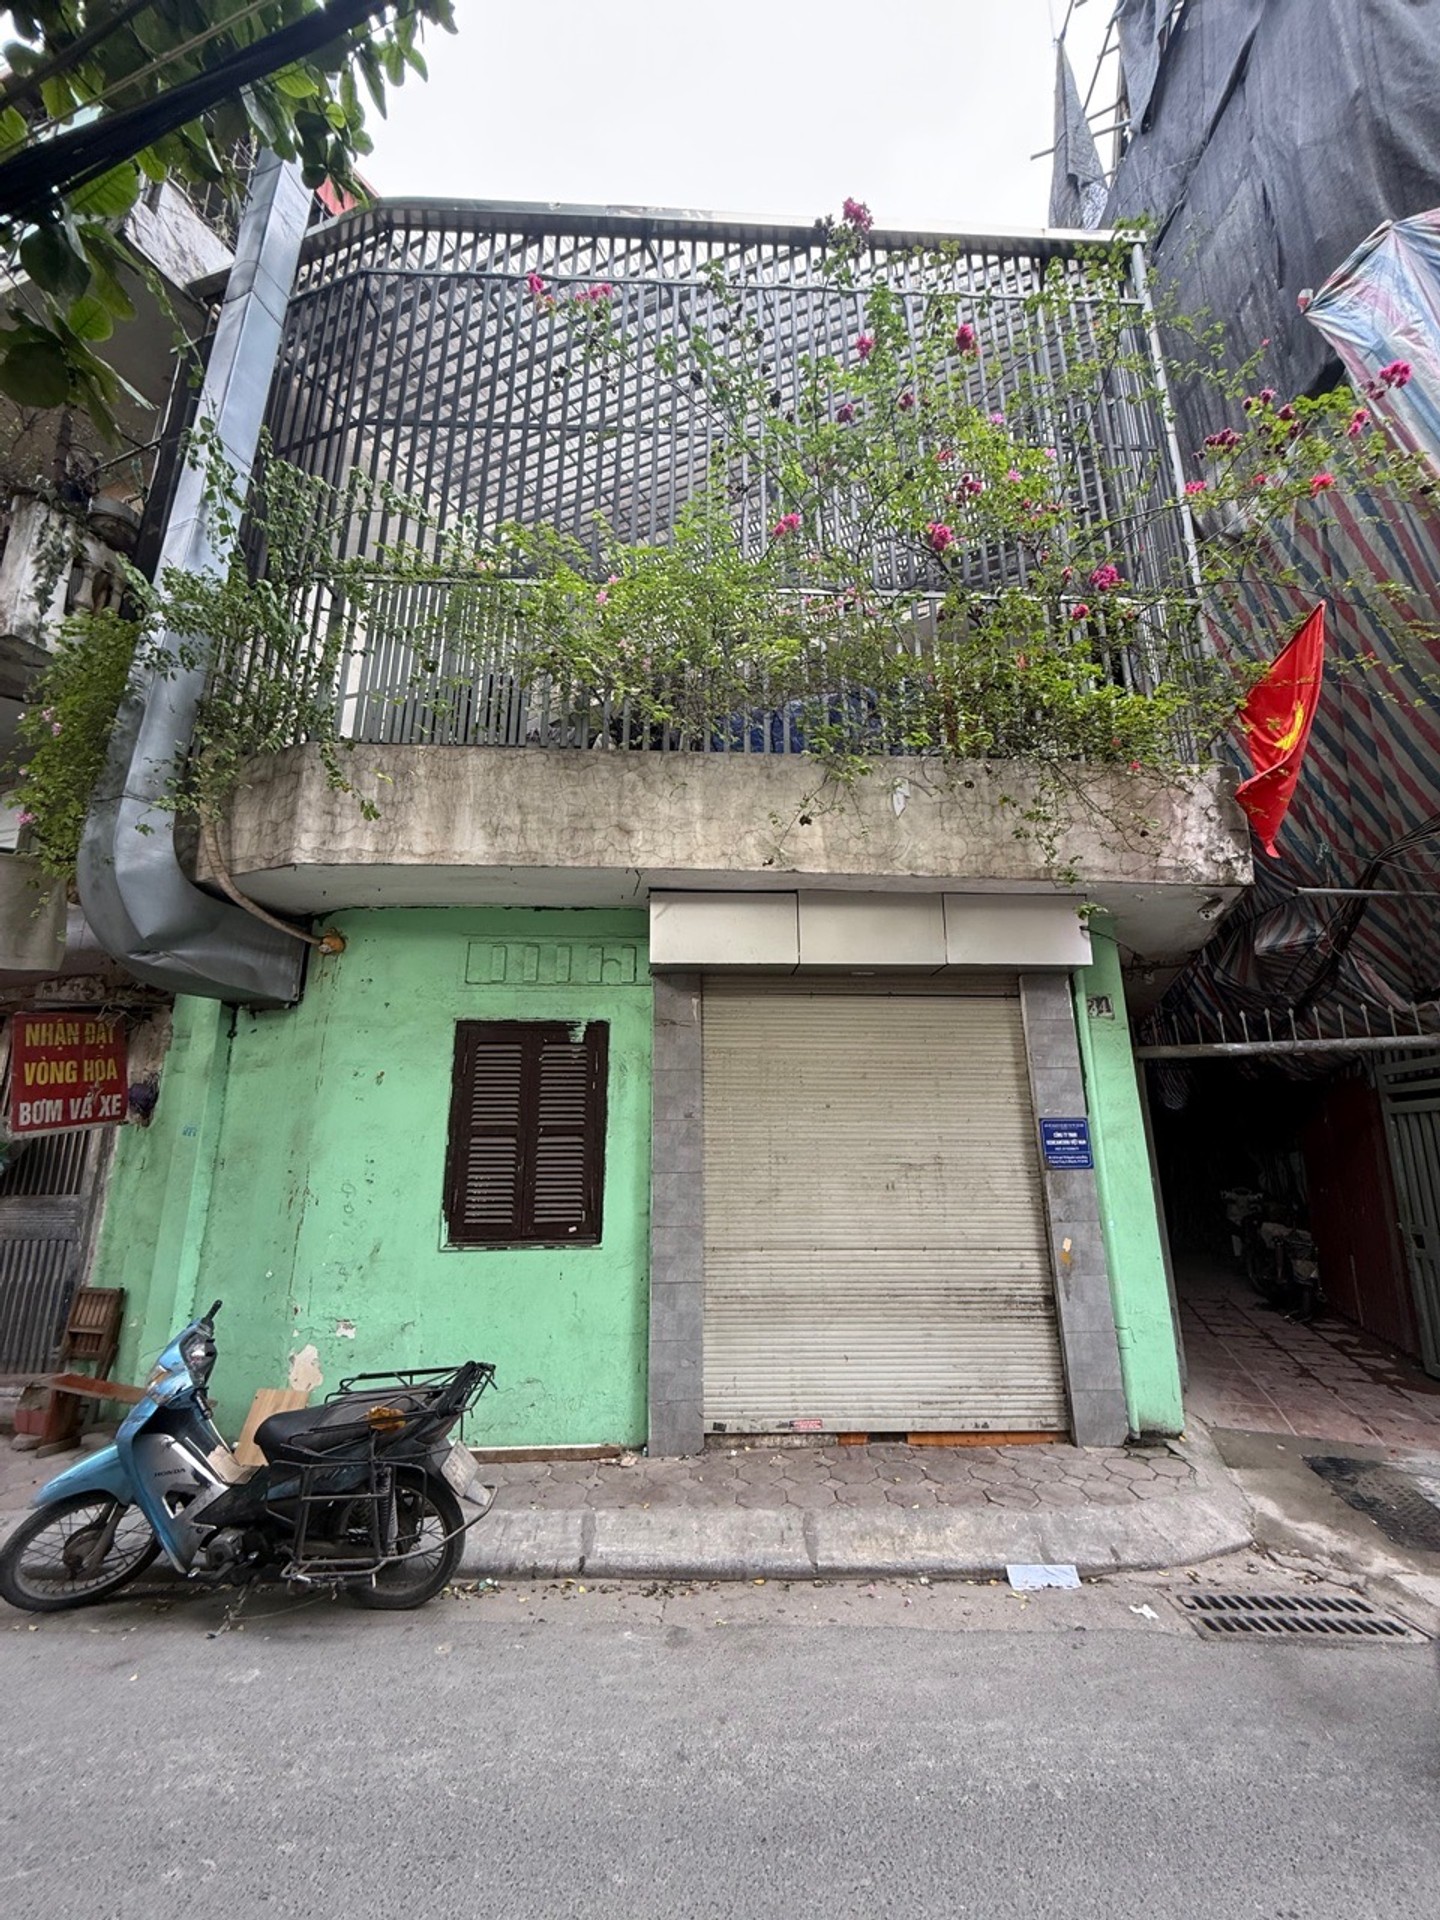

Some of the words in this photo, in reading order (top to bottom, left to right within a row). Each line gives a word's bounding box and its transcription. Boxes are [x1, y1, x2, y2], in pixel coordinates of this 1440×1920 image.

[25, 1018, 79, 1051] NHẬN
[24, 1056, 78, 1087] VÒNG
[19, 1098, 63, 1126] BƠM
[98, 1094, 122, 1118] XE
[154, 1468, 186, 1477] HONDA
